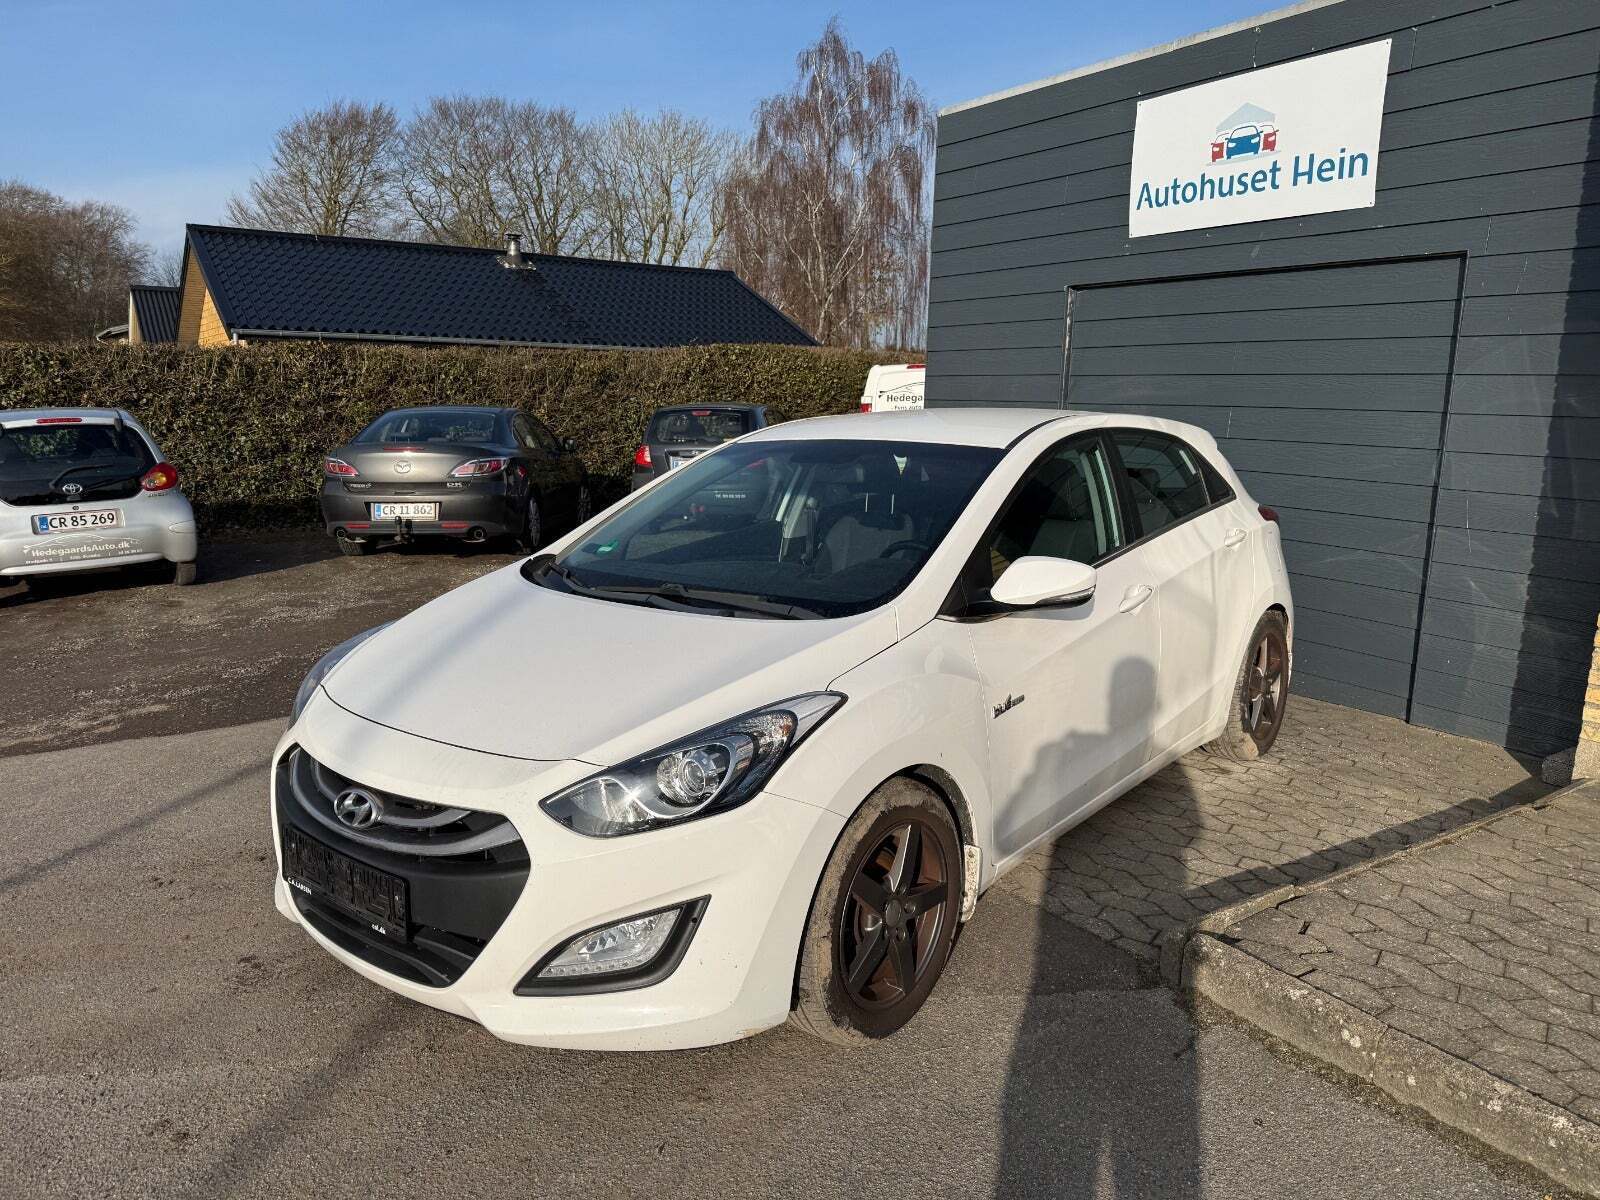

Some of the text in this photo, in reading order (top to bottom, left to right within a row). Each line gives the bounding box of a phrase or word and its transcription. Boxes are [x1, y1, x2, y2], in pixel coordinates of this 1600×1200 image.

[1136, 148, 1369, 210] Autohuset Hein
[382, 505, 396, 515] CR
[399, 505, 411, 515] 11
[413, 505, 433, 515] 862
[49, 513, 115, 529] CR 85 269
